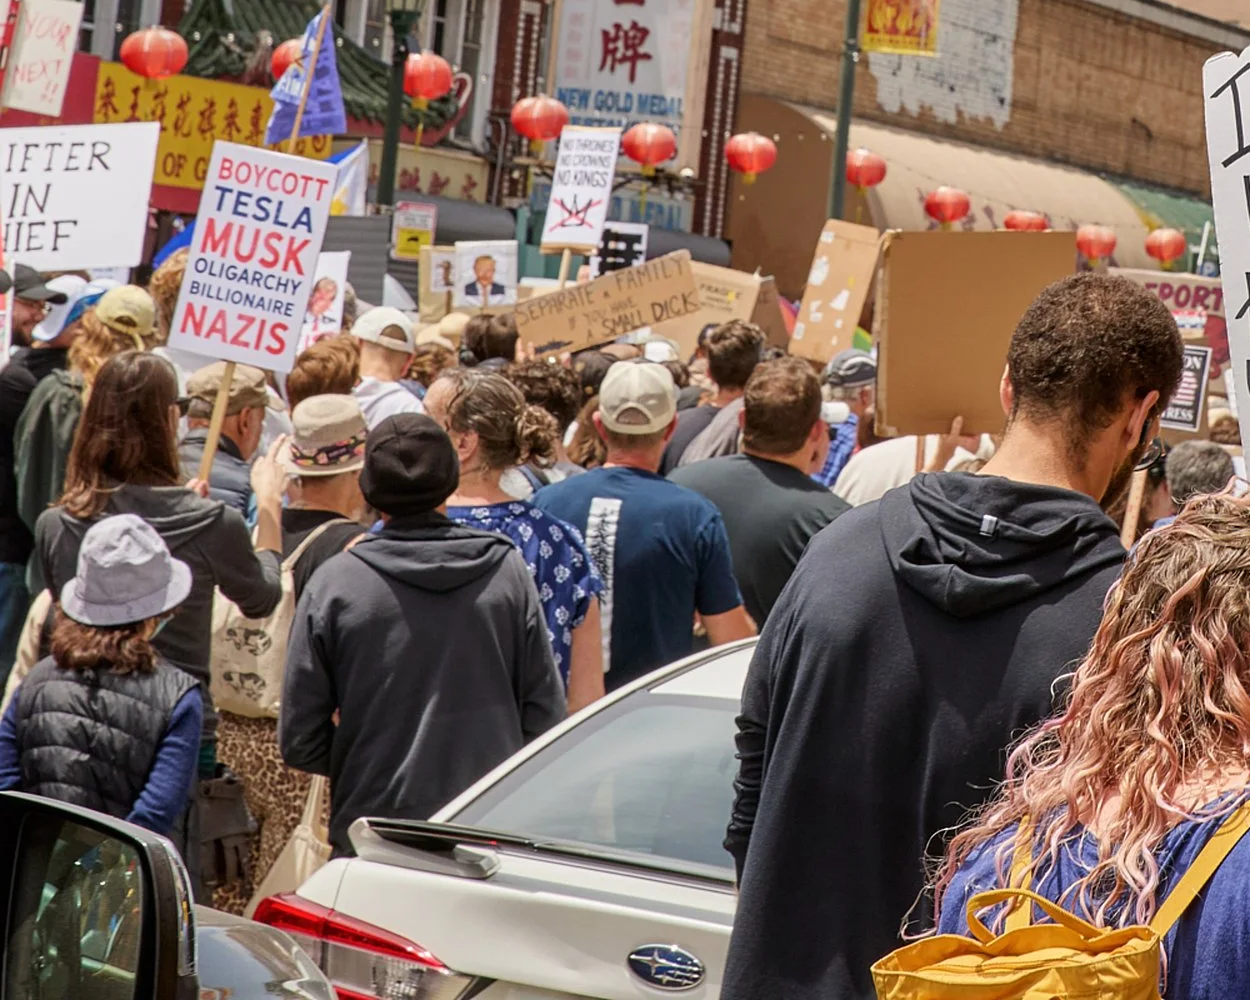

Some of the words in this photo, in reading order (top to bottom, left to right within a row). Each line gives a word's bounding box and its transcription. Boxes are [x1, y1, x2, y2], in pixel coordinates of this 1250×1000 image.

[11, 60, 63, 89] NEXT
[557, 87, 592, 110] NEW
[594, 90, 633, 113] GOLD
[637, 93, 683, 117] MEDAL
[5, 141, 111, 172] IFTER
[573, 155, 611, 168] CROWNS
[576, 138, 615, 152] THRONES
[163, 153, 187, 178] OF
[218, 157, 329, 201] BOYCOTT
[558, 170, 571, 186] NO
[573, 170, 609, 188] KINGS
[8, 183, 51, 219] IN
[215, 185, 313, 233] TESLA
[200, 217, 312, 276] MUSK
[194, 257, 302, 296] OLIGARCHY
[515, 286, 596, 327] SEPARATE
[615, 257, 685, 293] FAMILY
[189, 280, 295, 317] BILLIONAIRE
[601, 310, 647, 338] SMALL
[651, 290, 699, 323] DICK
[180, 302, 289, 355] NAZIS
